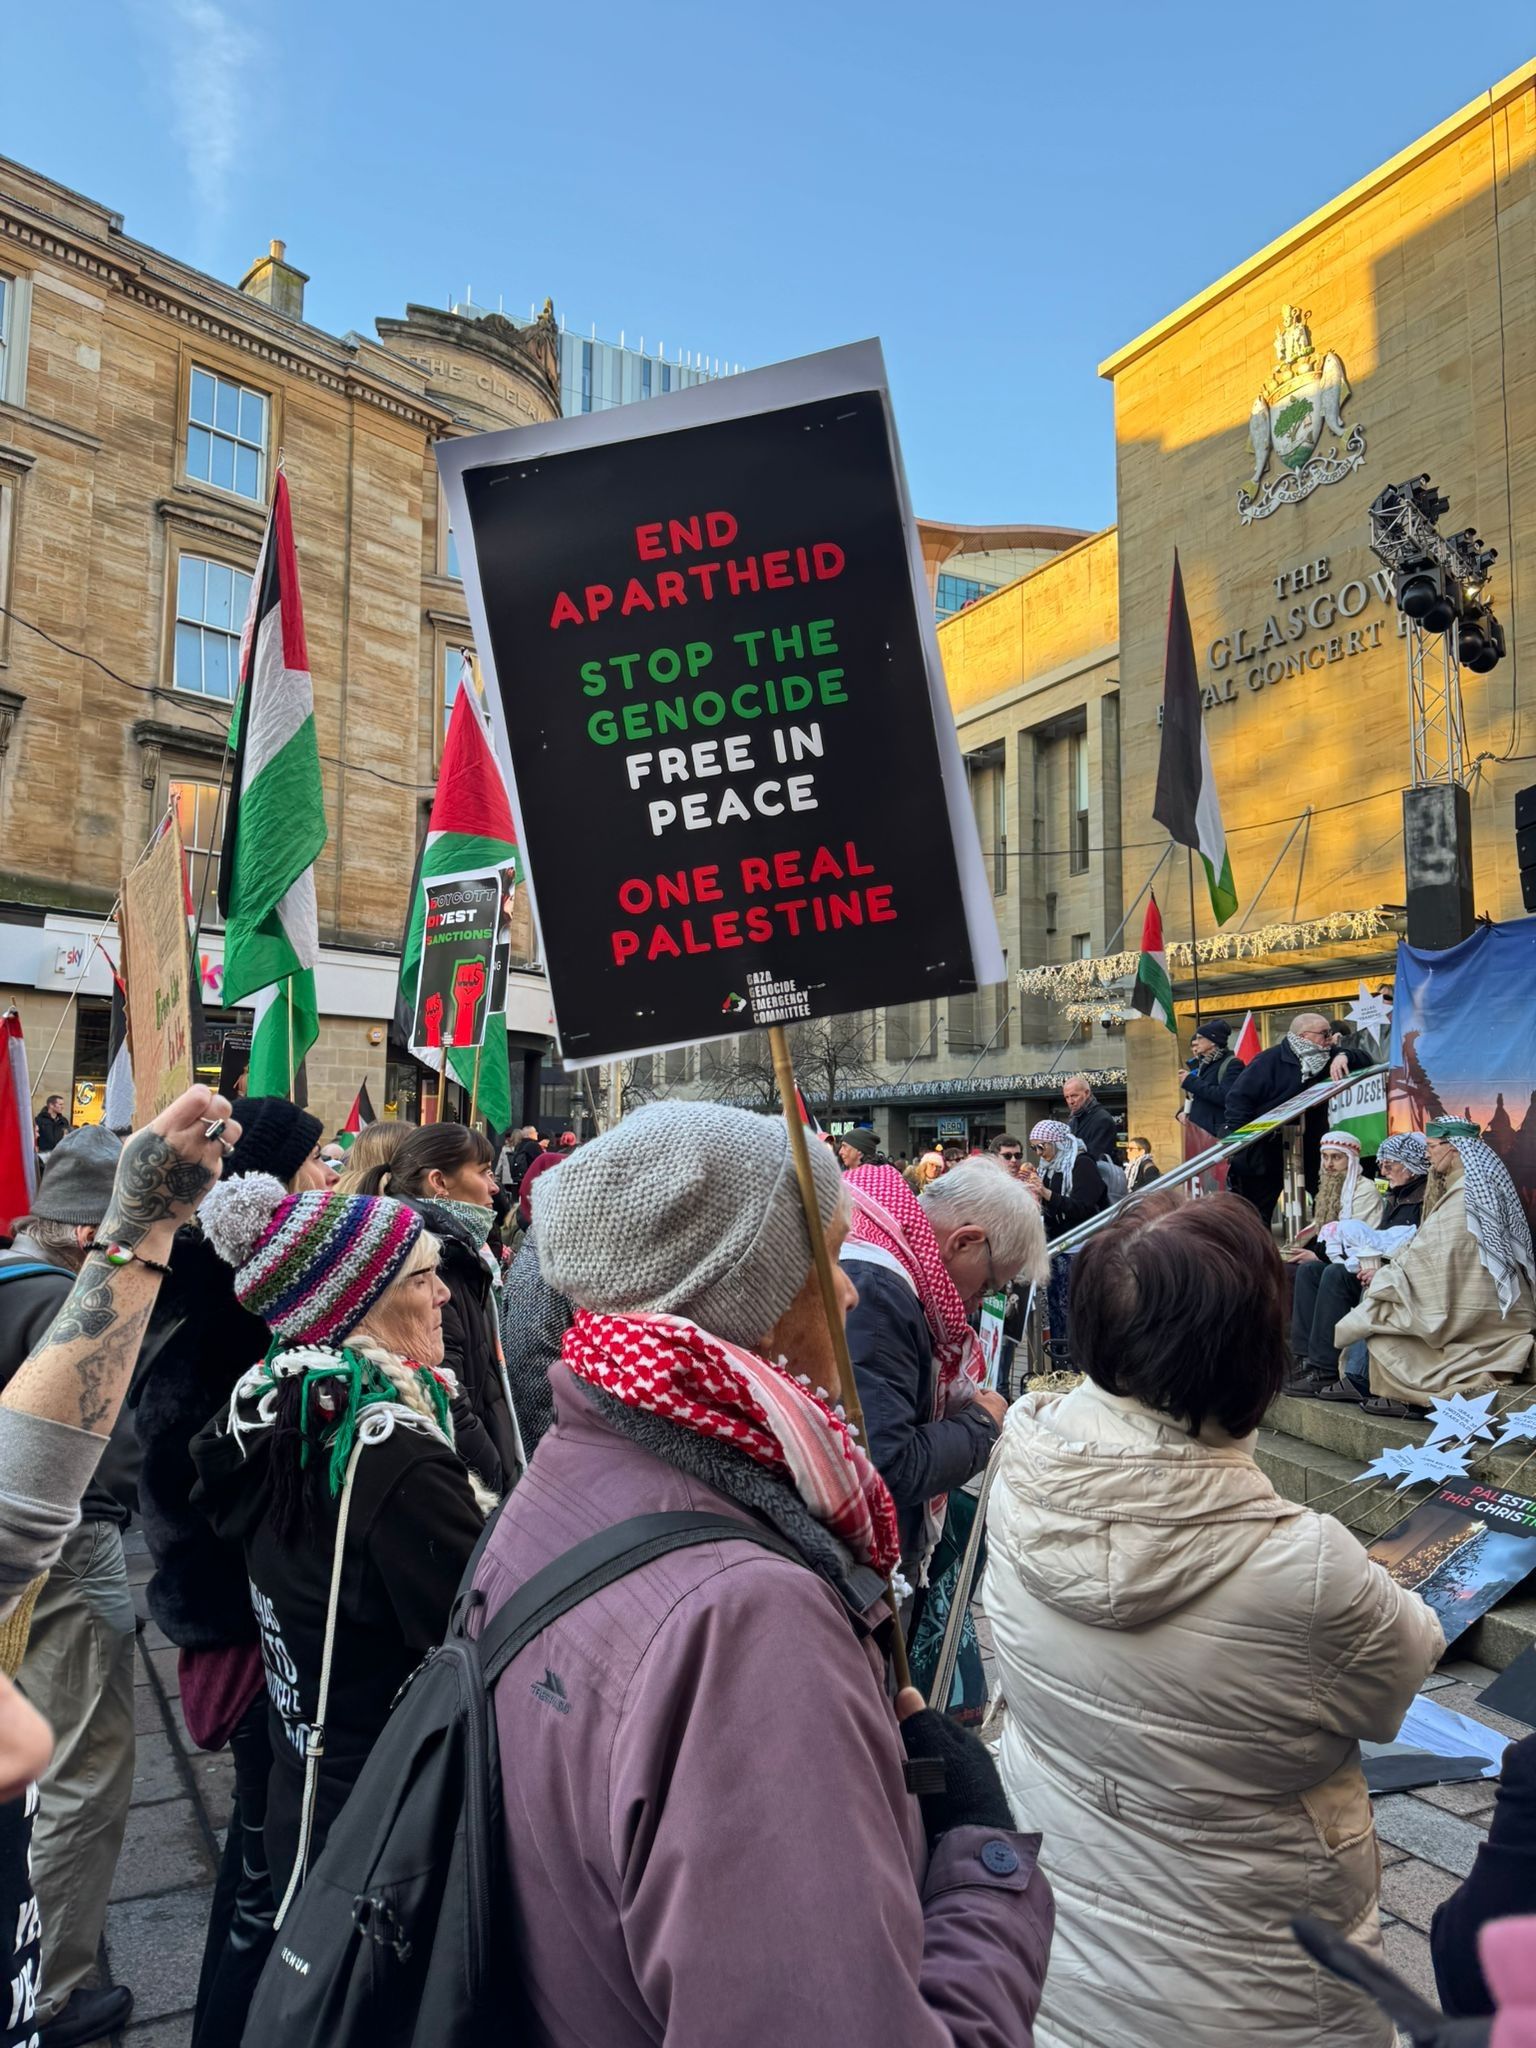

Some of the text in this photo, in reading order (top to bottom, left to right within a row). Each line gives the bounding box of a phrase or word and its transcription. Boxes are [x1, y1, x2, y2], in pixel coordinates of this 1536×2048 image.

[1253, 503, 1272, 517] LET
[1278, 477, 1315, 501] GLASGOW
[635, 511, 738, 561] END
[550, 543, 846, 629] APARTHEID
[1273, 556, 1331, 600] THE
[1206, 567, 1398, 671] GLASGOW
[580, 618, 839, 697] STOP THE
[1247, 620, 1385, 692] CONCERT
[587, 668, 848, 745] GENOCIDE
[626, 722, 824, 790] FREE IN
[648, 774, 818, 836] PEACE
[429, 888, 497, 910] BOYCOTT
[618, 841, 875, 915] ONE REAL
[426, 909, 478, 928] DIVEST
[426, 928, 493, 946] SANCTIONS
[611, 884, 898, 966] PALESTINE
[67, 946, 84, 967] sky
[746, 970, 773, 986] GAZA
[748, 979, 797, 998] GENOCIDE
[751, 990, 809, 1011] EMERGENCY
[753, 1003, 812, 1025] COMMITTEE
[1440, 1489, 1475, 1508] THIS
